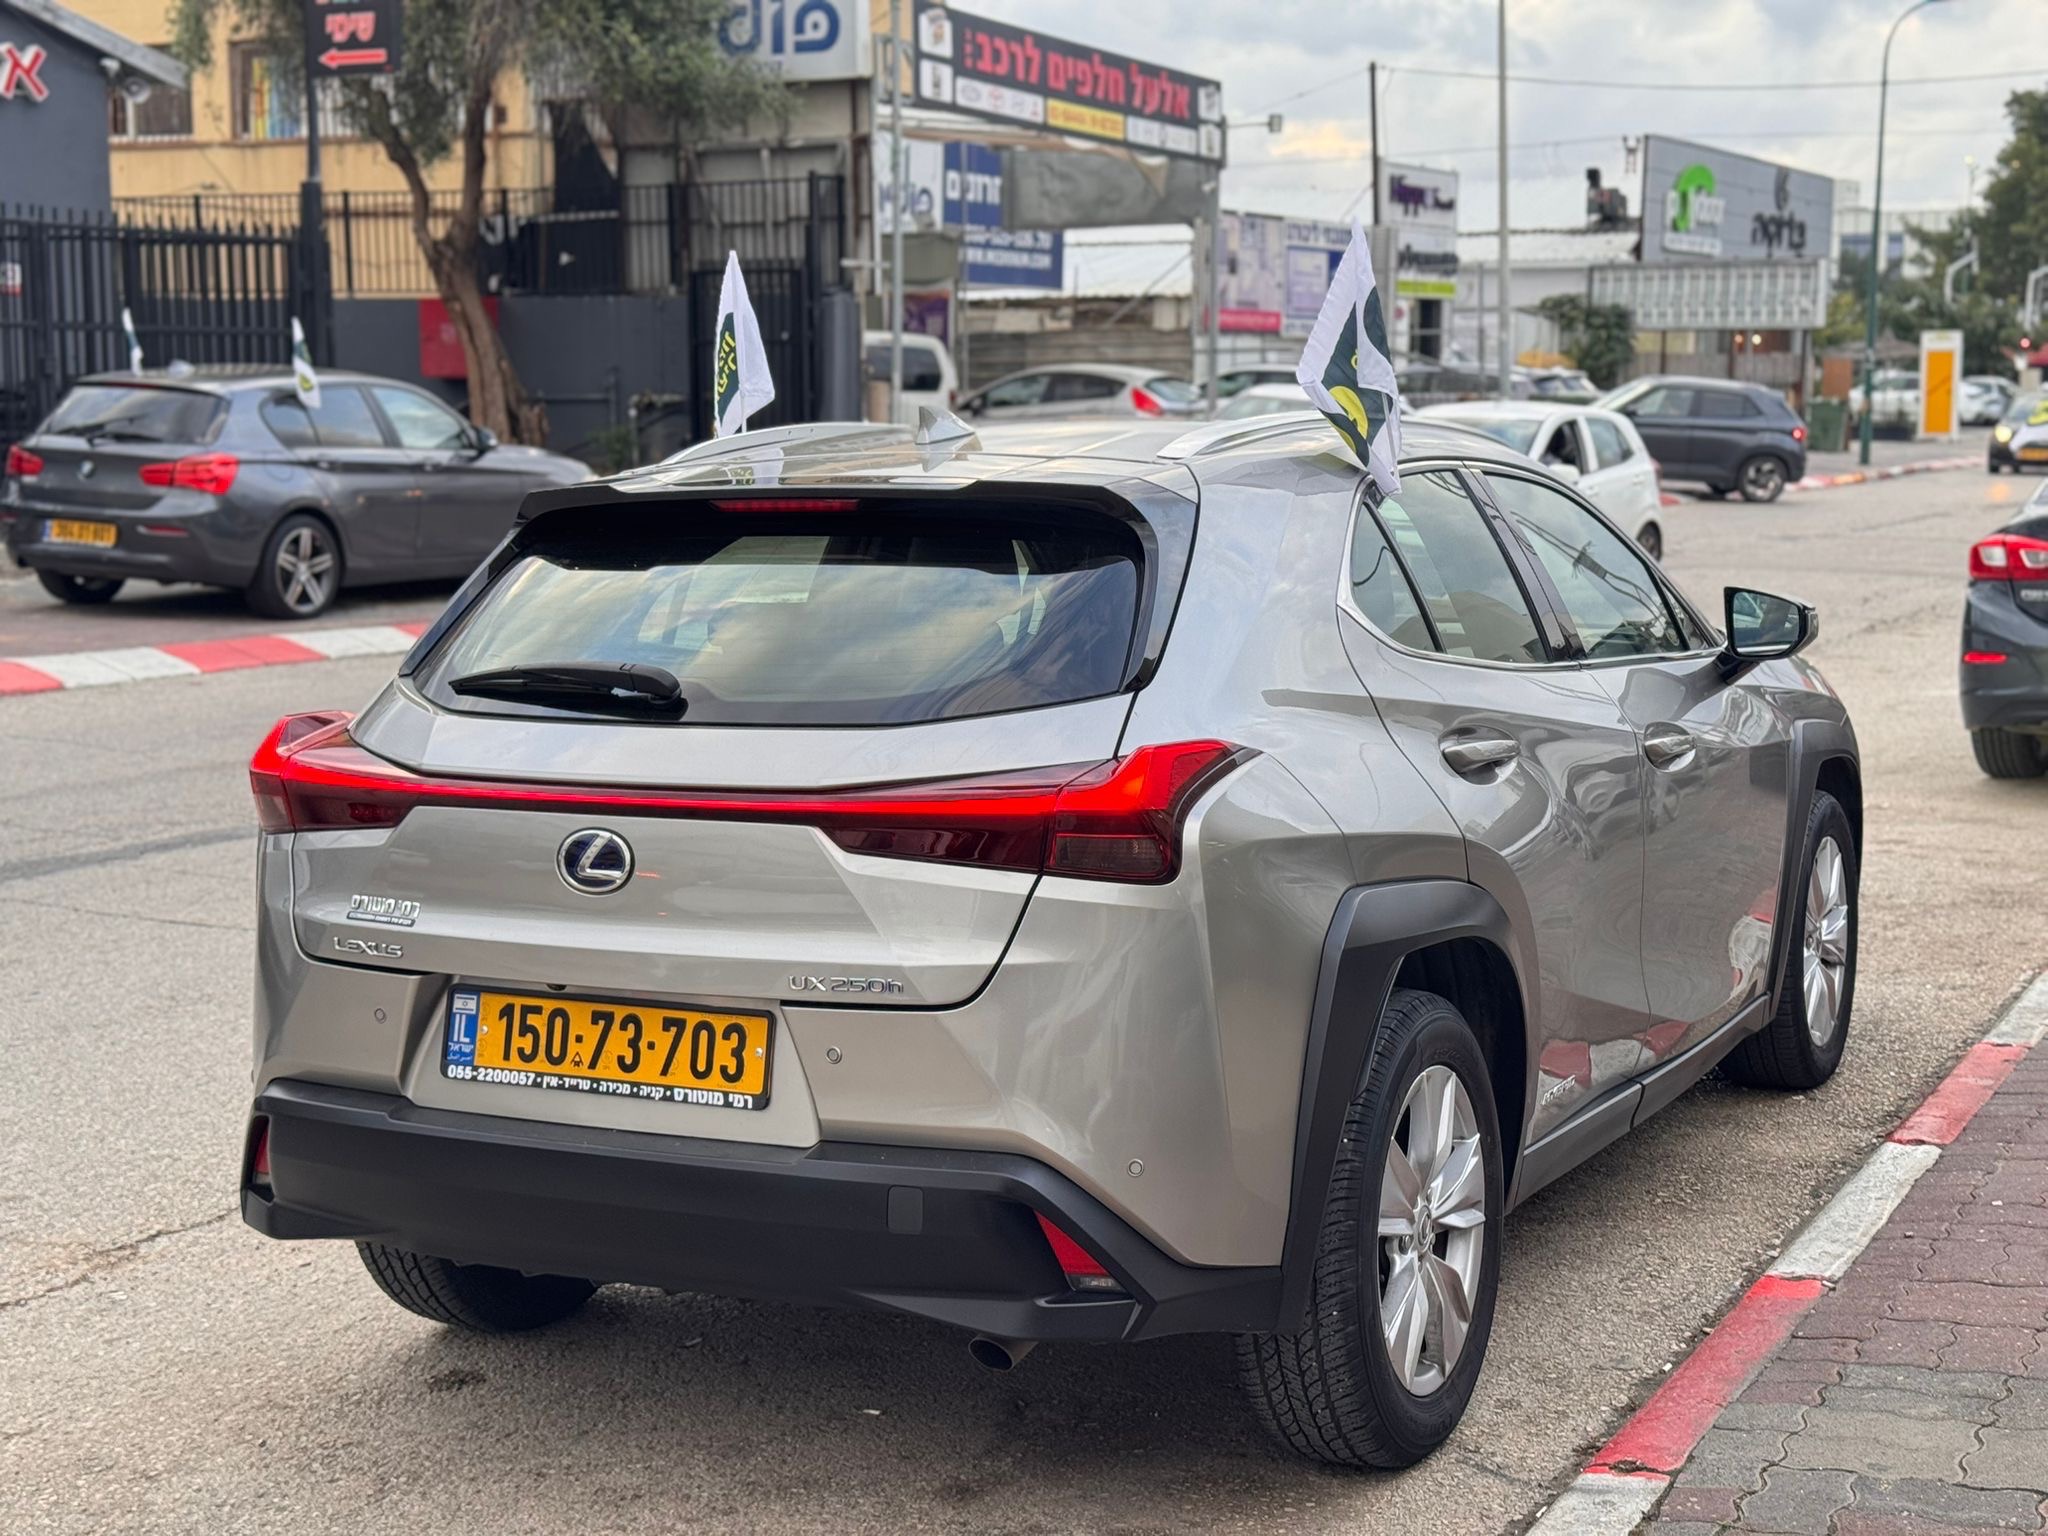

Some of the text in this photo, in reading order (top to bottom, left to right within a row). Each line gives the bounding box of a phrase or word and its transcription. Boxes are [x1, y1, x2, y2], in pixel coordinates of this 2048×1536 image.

[1047, 50, 1126, 105] חלפים
[351, 894, 396, 914] מוטורס
[399, 899, 421, 919] רמי
[333, 936, 404, 958] LEXUS
[789, 975, 904, 993] UX 250h
[453, 1014, 471, 1043] IL
[447, 1064, 753, 1109] רמי מוטורס קניה מכירה טרייד-אין 055-2200057
